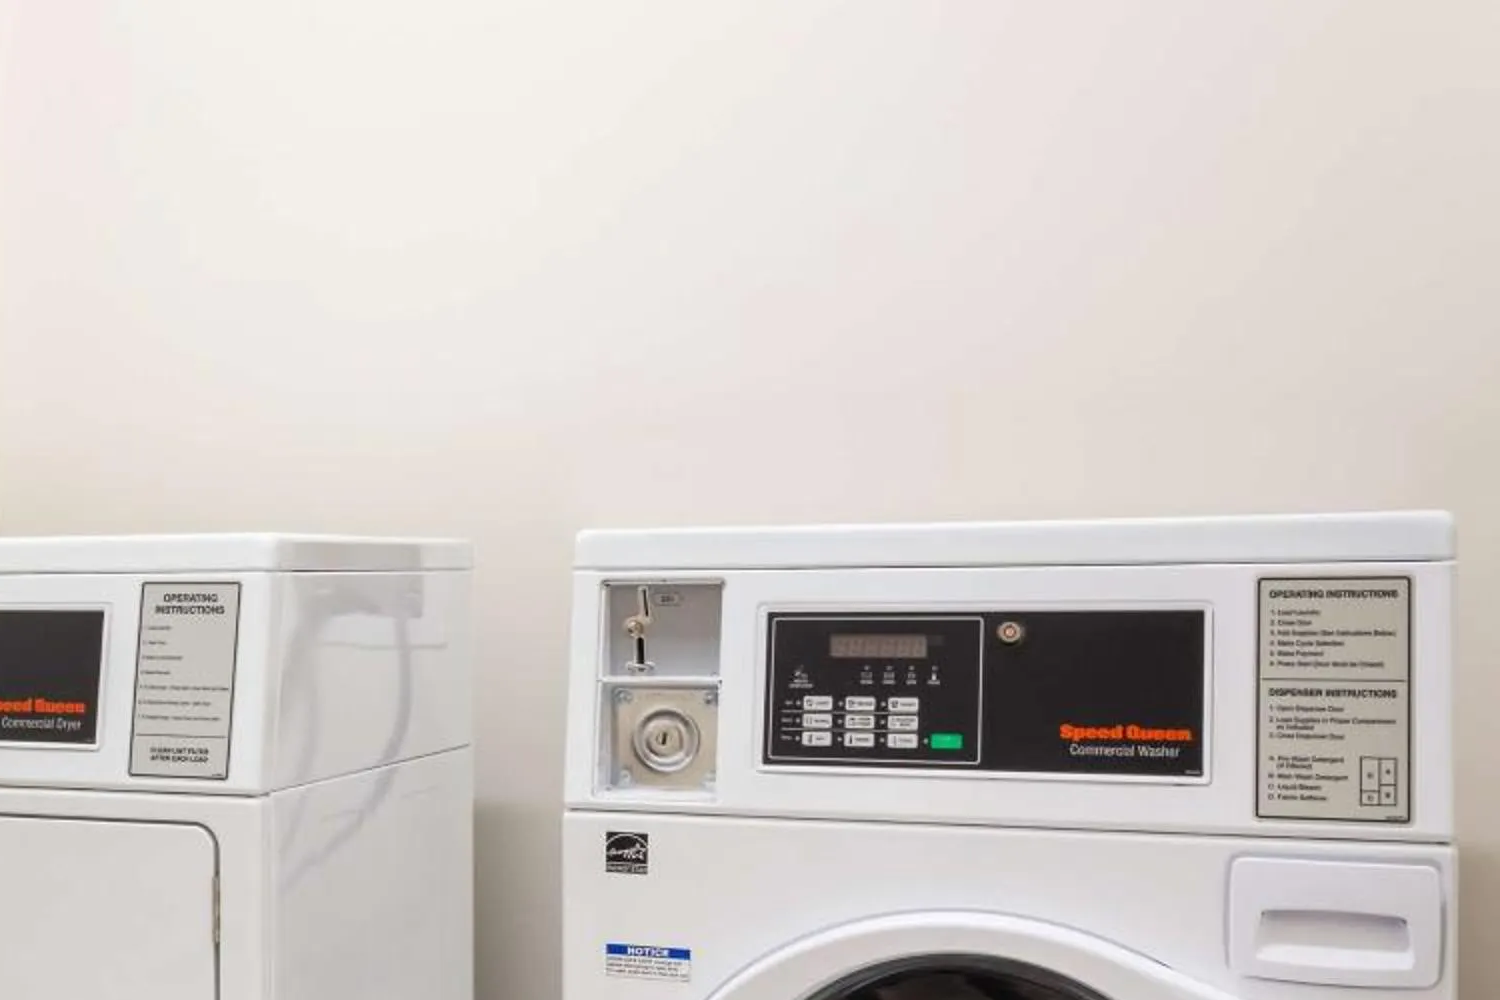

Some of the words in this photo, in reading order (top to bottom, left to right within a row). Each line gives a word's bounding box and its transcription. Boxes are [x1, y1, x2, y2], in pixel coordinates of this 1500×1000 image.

[163, 593, 218, 603] OPERATING
[1269, 589, 1325, 599] OPERATING
[1326, 589, 1398, 599] INSTRUCTIONS
[155, 605, 226, 615] INSTRUCTIONS
[1268, 688, 1323, 697] DISPENSER
[1325, 688, 1398, 698] INSTRUCTIONS
[34, 698, 86, 713] Queen
[1, 716, 55, 729] Commercial
[56, 718, 81, 732] Dryer
[1059, 723, 1124, 741] Speed
[1126, 723, 1192, 741] Queen
[1069, 743, 1135, 757] Commercial
[1137, 745, 1181, 758] Washer
[627, 946, 669, 957] NOTICE
